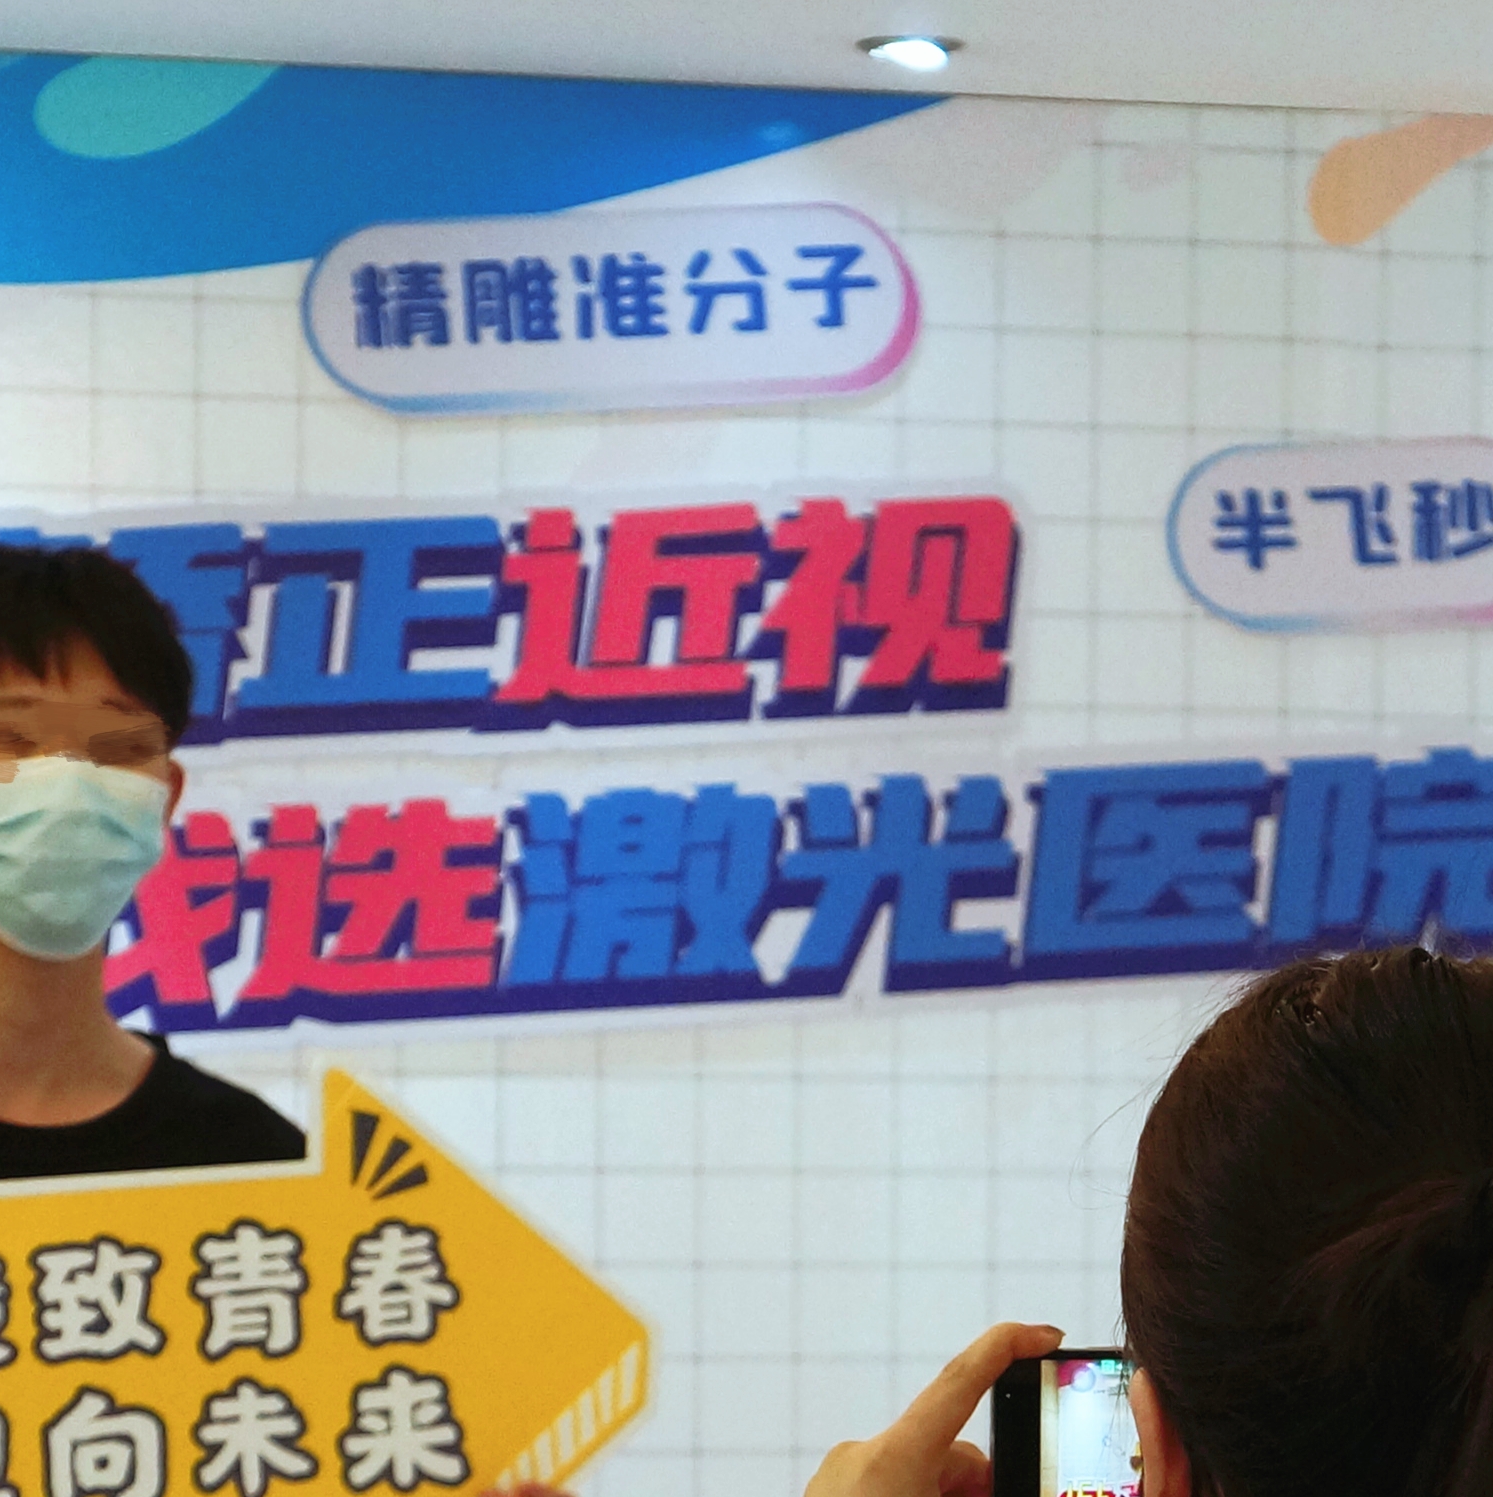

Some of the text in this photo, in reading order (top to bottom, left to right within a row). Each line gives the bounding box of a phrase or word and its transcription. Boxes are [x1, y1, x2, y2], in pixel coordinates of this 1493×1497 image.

[351, 243, 880, 348] 精雕准分子
